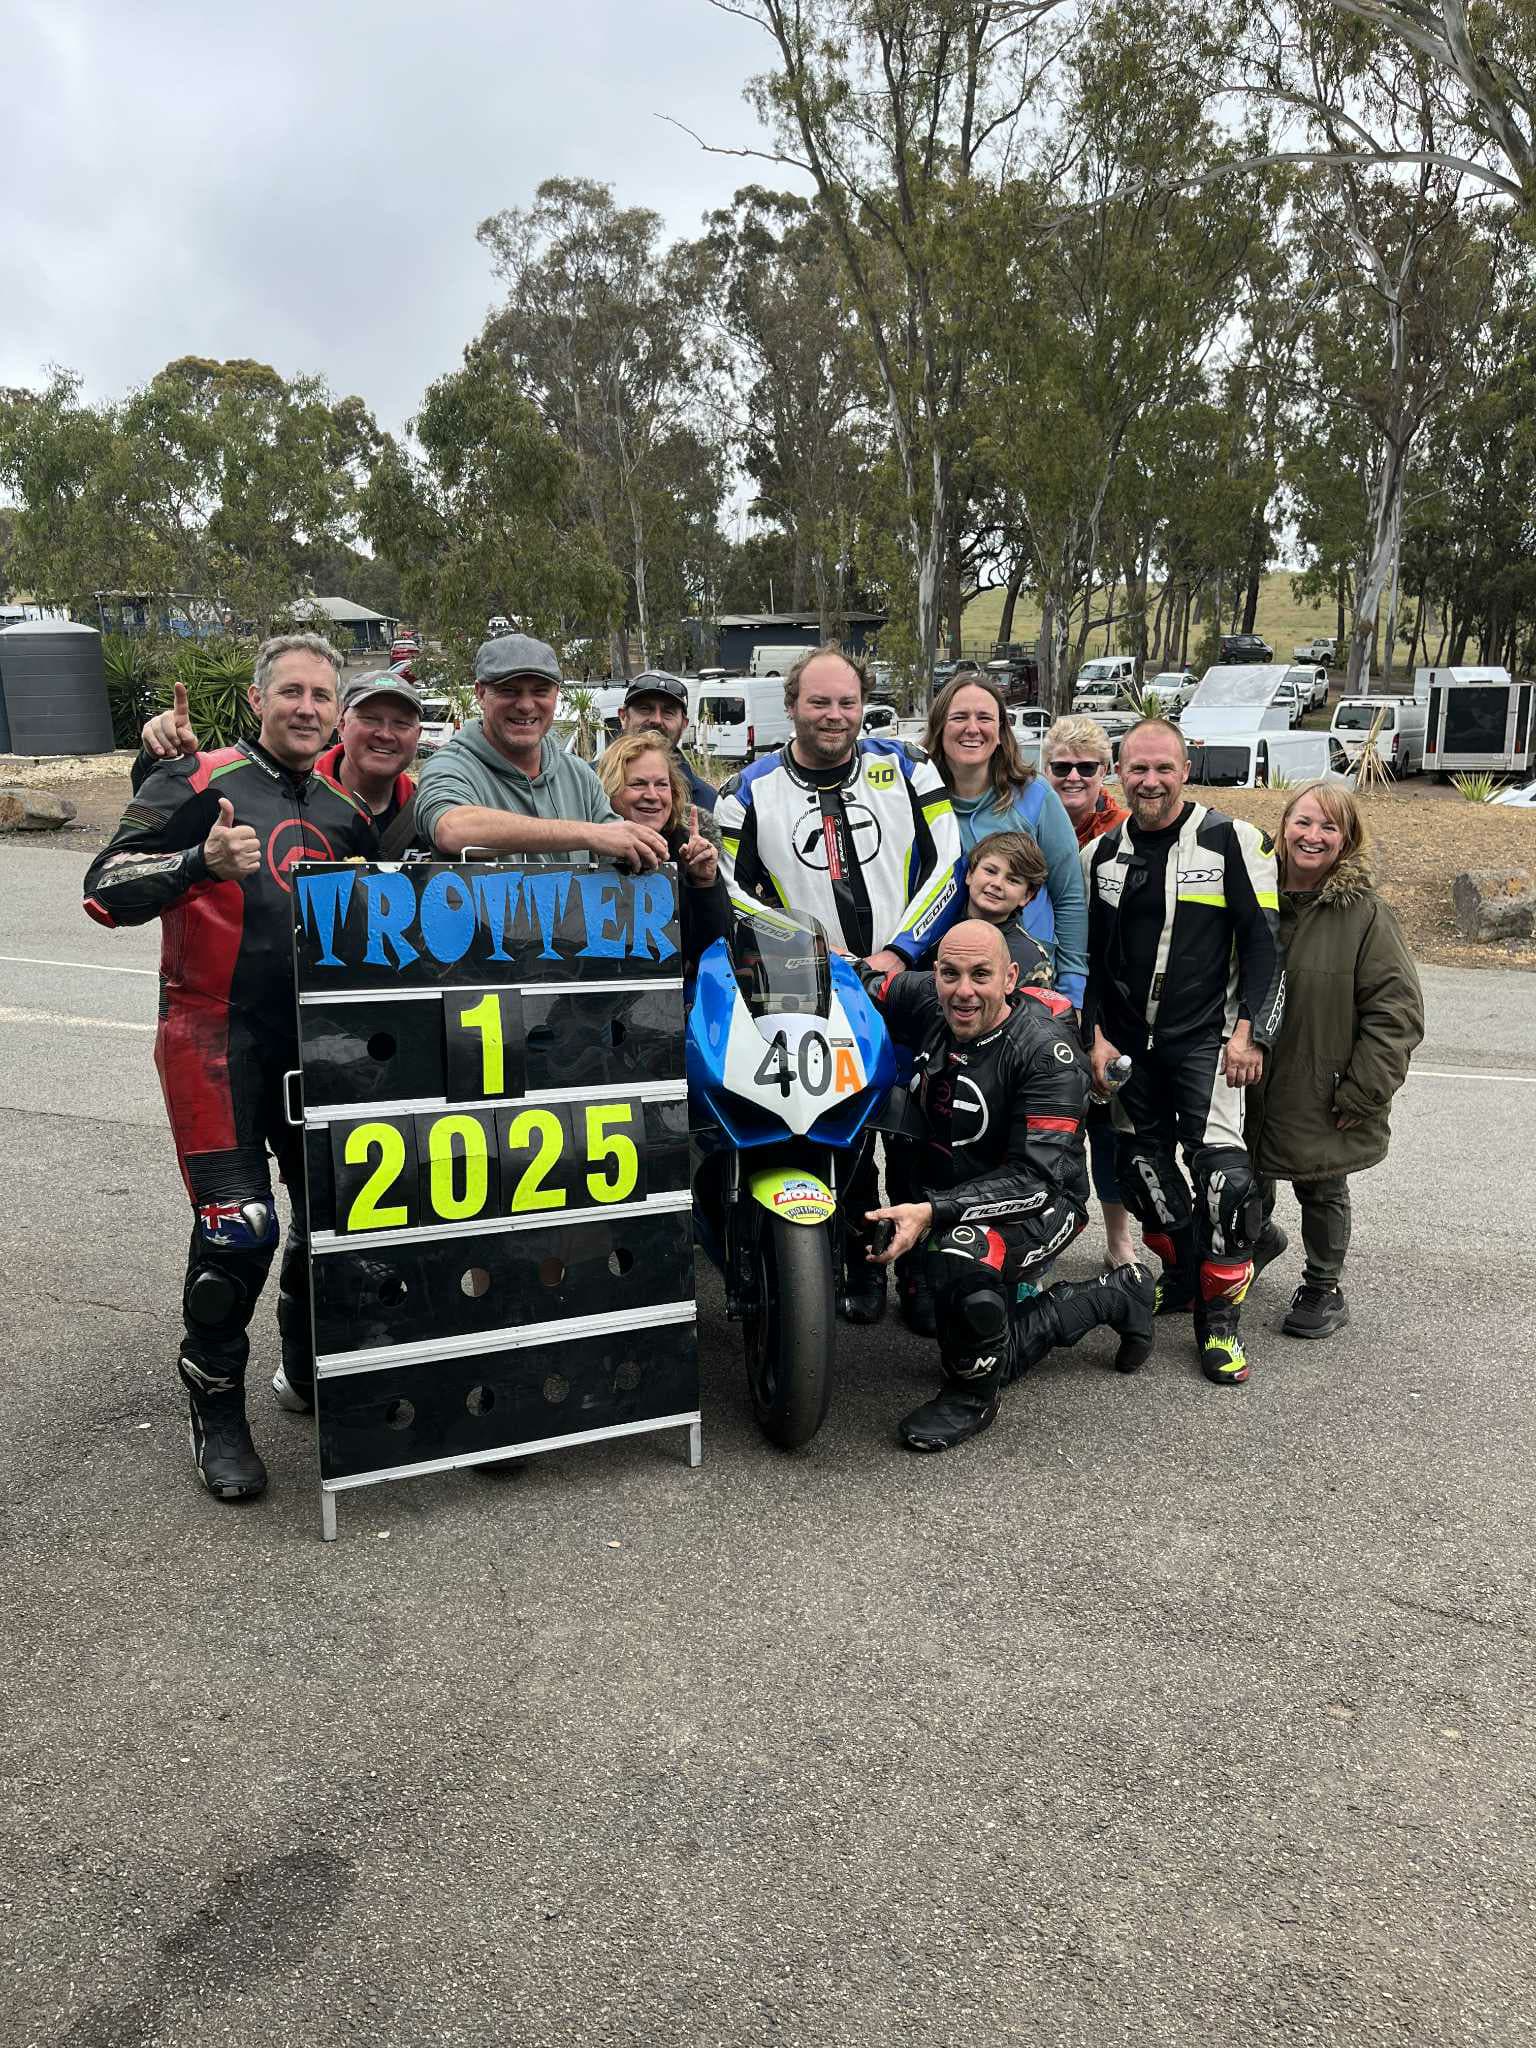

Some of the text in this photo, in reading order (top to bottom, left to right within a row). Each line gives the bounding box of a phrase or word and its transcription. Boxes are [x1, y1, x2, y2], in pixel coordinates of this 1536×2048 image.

[867, 769, 895, 783] 40
[296, 870, 678, 971] TROTTER
[914, 882, 956, 937] ricondi
[460, 993, 504, 1095] 1
[754, 1030, 863, 1097] 40 A
[344, 1103, 638, 1231] 2025
[965, 1196, 1044, 1218] ricondi
